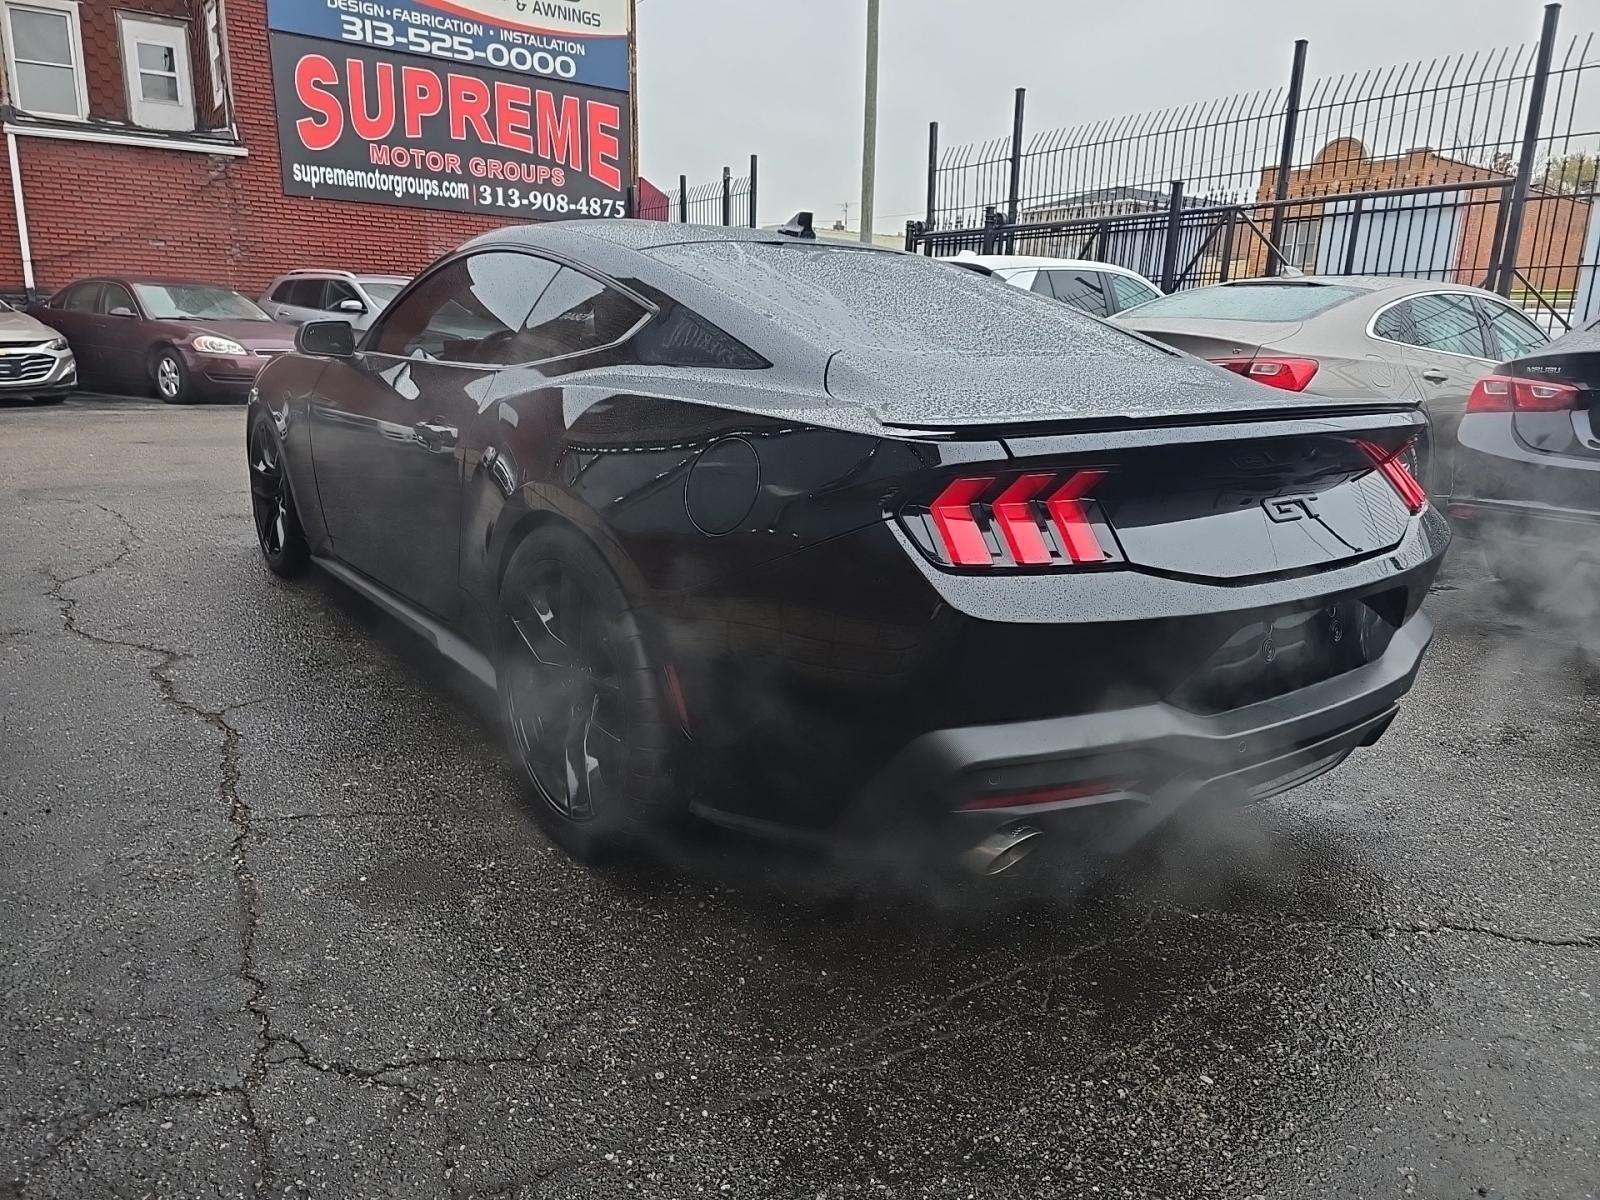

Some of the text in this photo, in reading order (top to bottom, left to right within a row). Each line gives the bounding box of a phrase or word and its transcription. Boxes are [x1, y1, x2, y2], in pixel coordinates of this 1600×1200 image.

[327, 0, 586, 56] DESIGN FABRICATION INSTALLATION
[532, 1, 601, 28] AWNINGS
[340, 14, 577, 79] 313-525-0000
[294, 53, 622, 192] SUPREME
[292, 162, 627, 219] suprememotorgroups.com 313-908-4875
[369, 143, 566, 187] MOTOR GROUPS
[1260, 492, 1320, 524] GT
